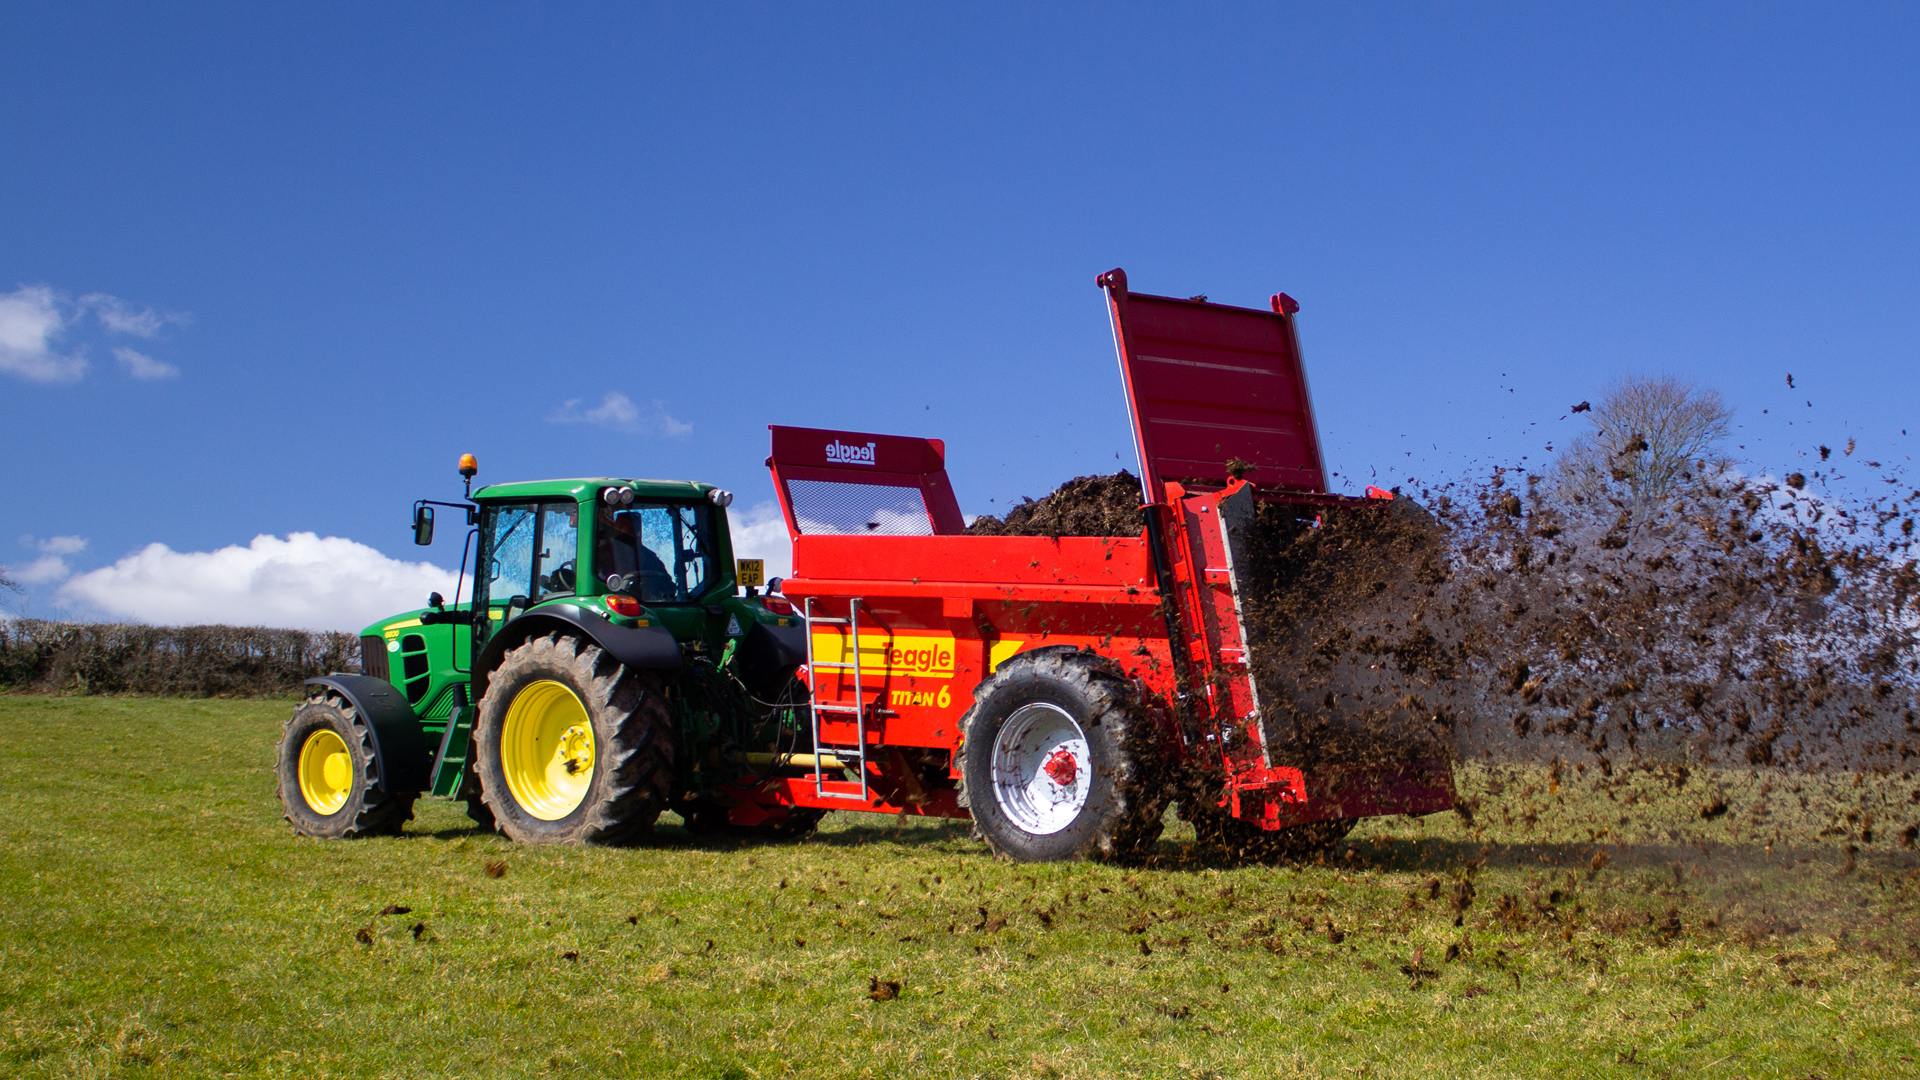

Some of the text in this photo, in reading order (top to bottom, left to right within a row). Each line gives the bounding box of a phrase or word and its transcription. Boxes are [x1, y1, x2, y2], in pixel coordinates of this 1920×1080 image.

[741, 573, 759, 584] EAP
[882, 641, 952, 672] Teagle
[891, 685, 951, 708] TITAN 6
